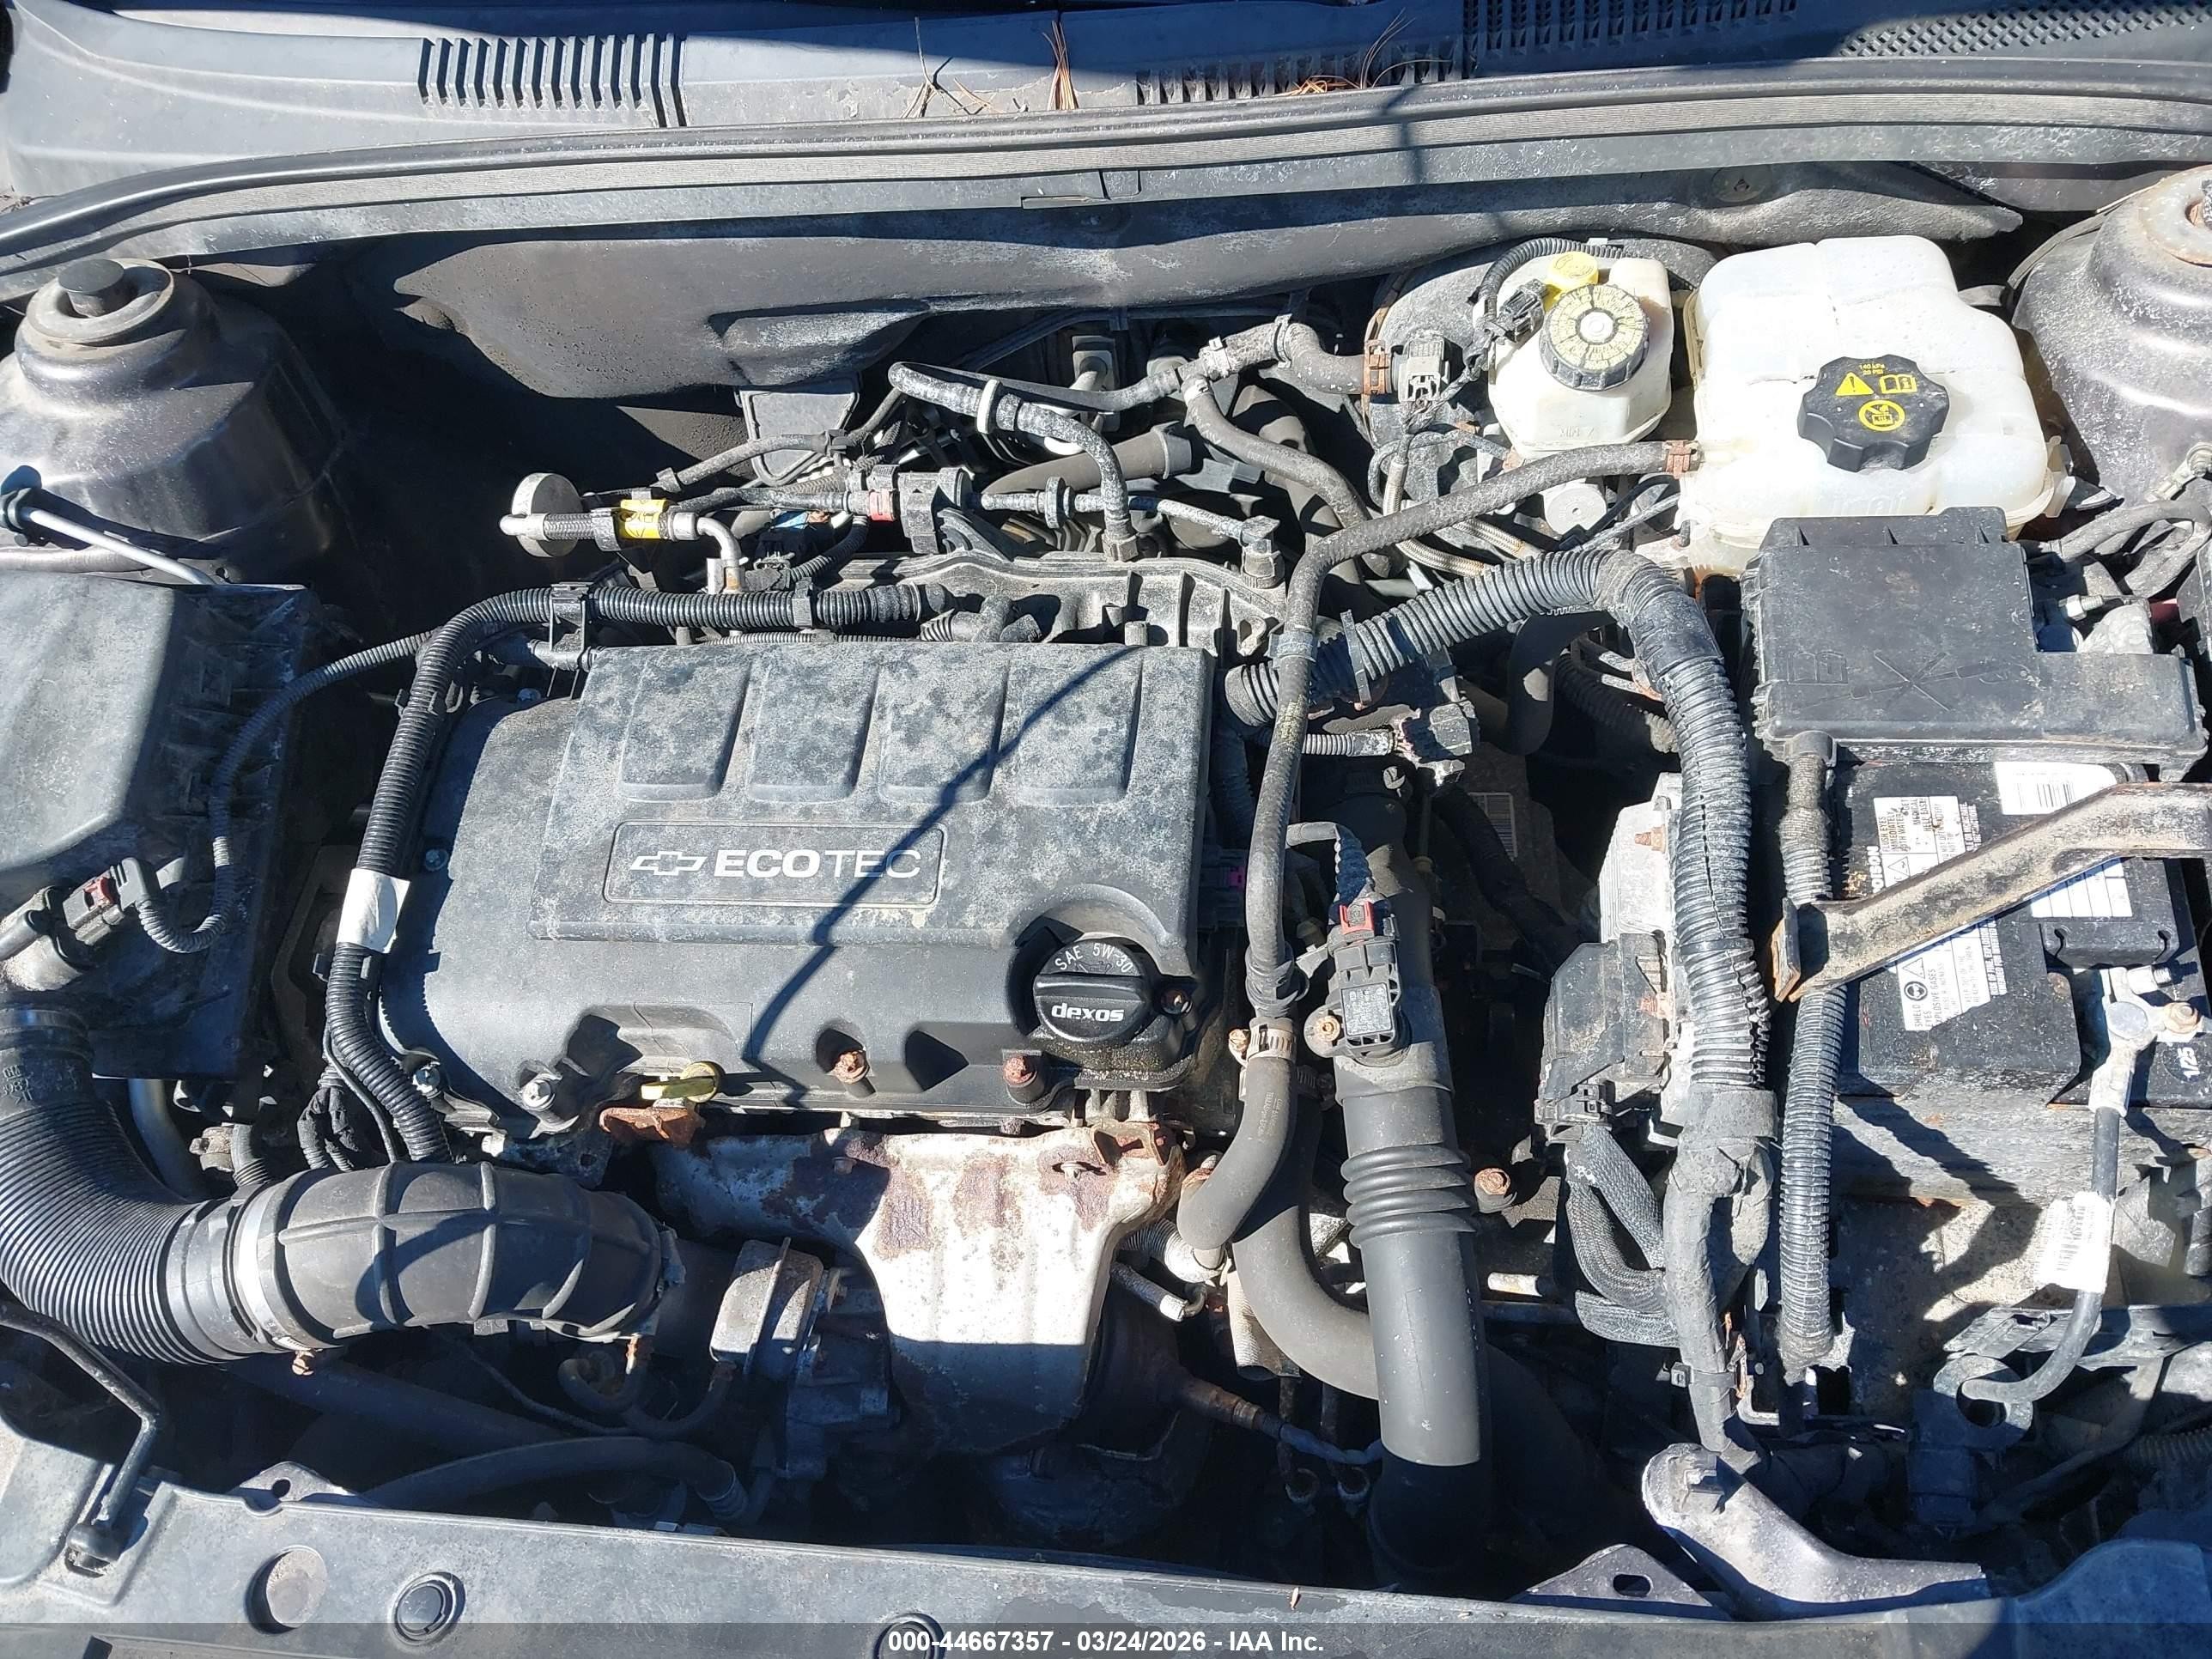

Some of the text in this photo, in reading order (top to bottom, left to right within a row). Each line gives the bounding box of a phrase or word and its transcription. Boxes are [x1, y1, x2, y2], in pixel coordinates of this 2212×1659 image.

[1879, 817, 1887, 832] EYES
[714, 850, 921, 878] ECOTEC
[1054, 942, 1134, 973] SAE 5W-30
[1927, 969, 1943, 1024] XPLOSIVE GASES
[1051, 1002, 1125, 1022] dexos
[1911, 1004, 1923, 1026] SHIELD
[2178, 1047, 2200, 1079] 1/25
